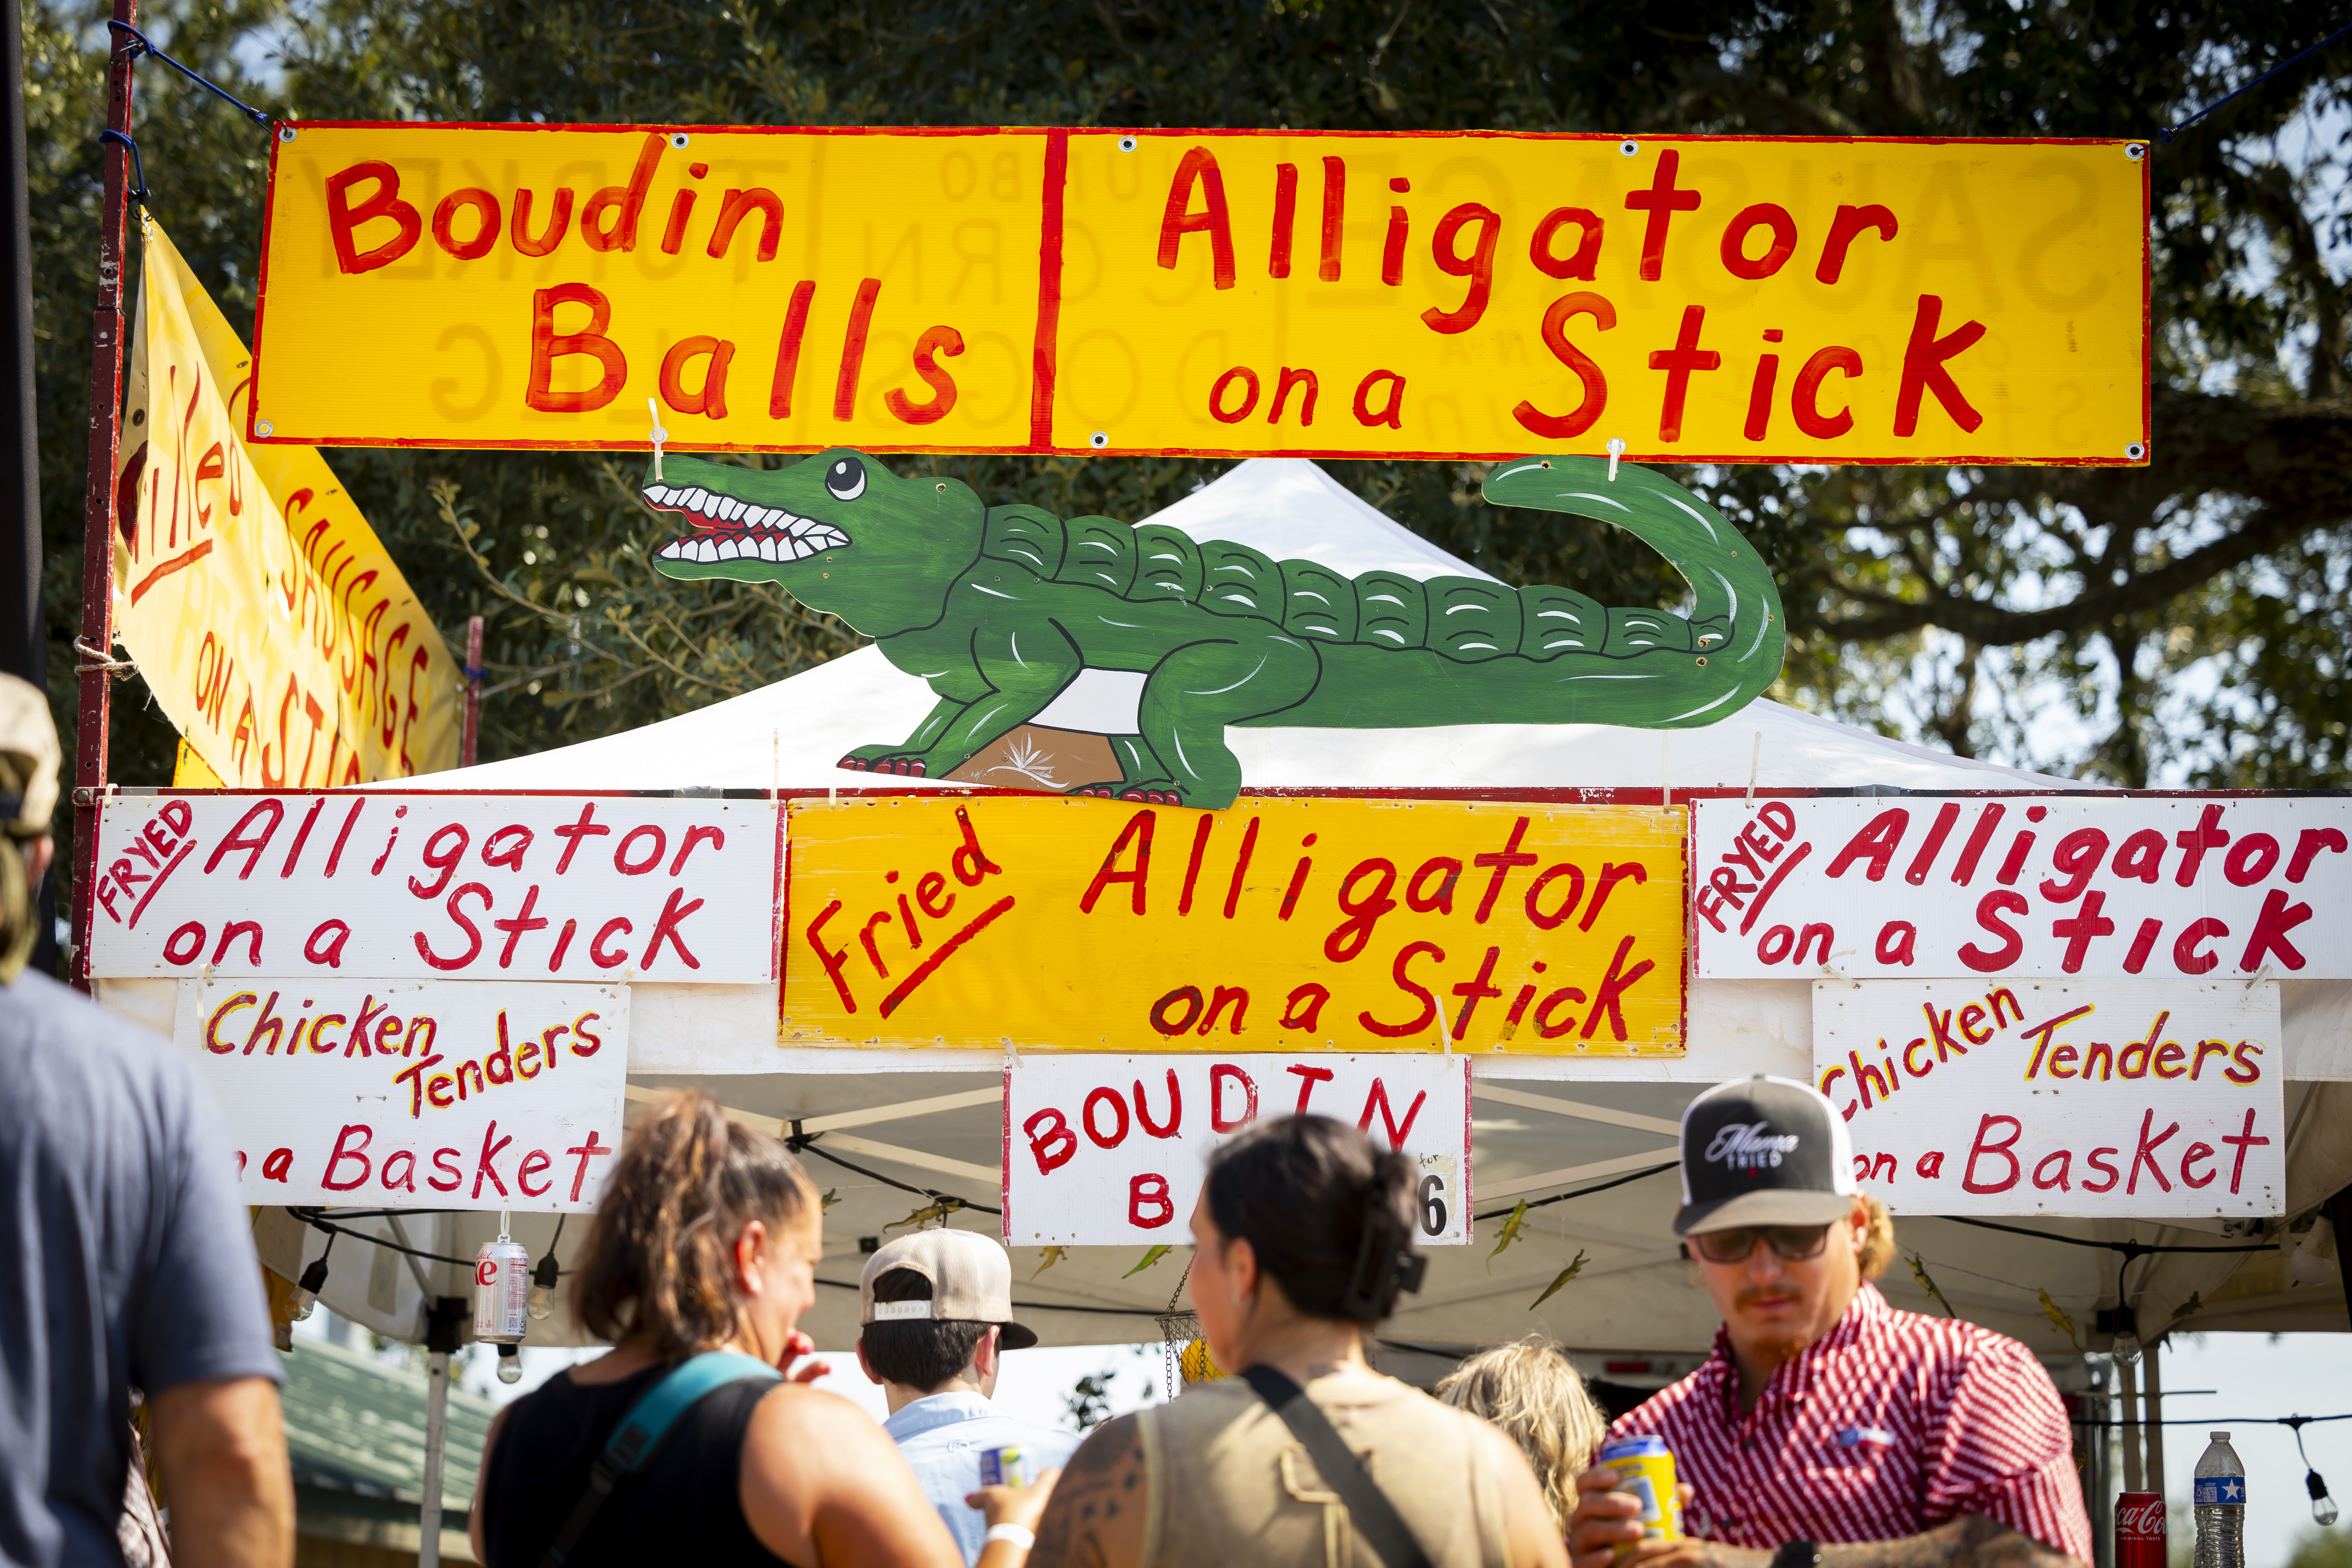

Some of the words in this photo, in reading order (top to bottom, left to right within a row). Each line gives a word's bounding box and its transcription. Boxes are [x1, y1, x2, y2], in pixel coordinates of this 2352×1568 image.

[325, 132, 786, 274] Boudin
[1158, 147, 1898, 334] Alligator
[526, 278, 965, 425] Balls
[1209, 366, 1318, 427] on
[1352, 369, 1406, 429] a
[1512, 291, 1987, 443] Stick
[282, 488, 427, 775] SAUSAGE
[196, 631, 233, 735] ON
[232, 680, 263, 776] A
[98, 800, 192, 922] FRYED
[204, 796, 724, 899] Alligator
[1079, 809, 1647, 963] Alligator
[1698, 802, 1795, 933] FRYED
[1825, 803, 2347, 903] Alligator
[163, 921, 263, 966] on
[304, 919, 350, 968] a
[414, 881, 704, 972] Stick
[808, 805, 1001, 1014] Fried
[1758, 923, 1834, 965] on
[1875, 921, 1916, 966] a
[1958, 889, 2312, 974] Stick
[1150, 985, 1250, 1036] on
[1278, 983, 1330, 1033] a
[1356, 933, 1655, 1042] Stick
[205, 991, 436, 1057] Chicken
[393, 1008, 601, 1118] Tenders
[1819, 986, 2024, 1121] Chicken
[2021, 1003, 2265, 1087] Tenders
[263, 1148, 293, 1182] a
[322, 1120, 612, 1202] Basket
[1023, 1064, 1426, 1175] BOUDIN
[1419, 1152, 1438, 1170] for
[1726, 1150, 1783, 1170] TRIED
[1853, 1152, 1897, 1183] on
[1917, 1152, 1944, 1179] a
[1962, 1109, 2269, 1194] Basket
[477, 1250, 493, 1260] Diet
